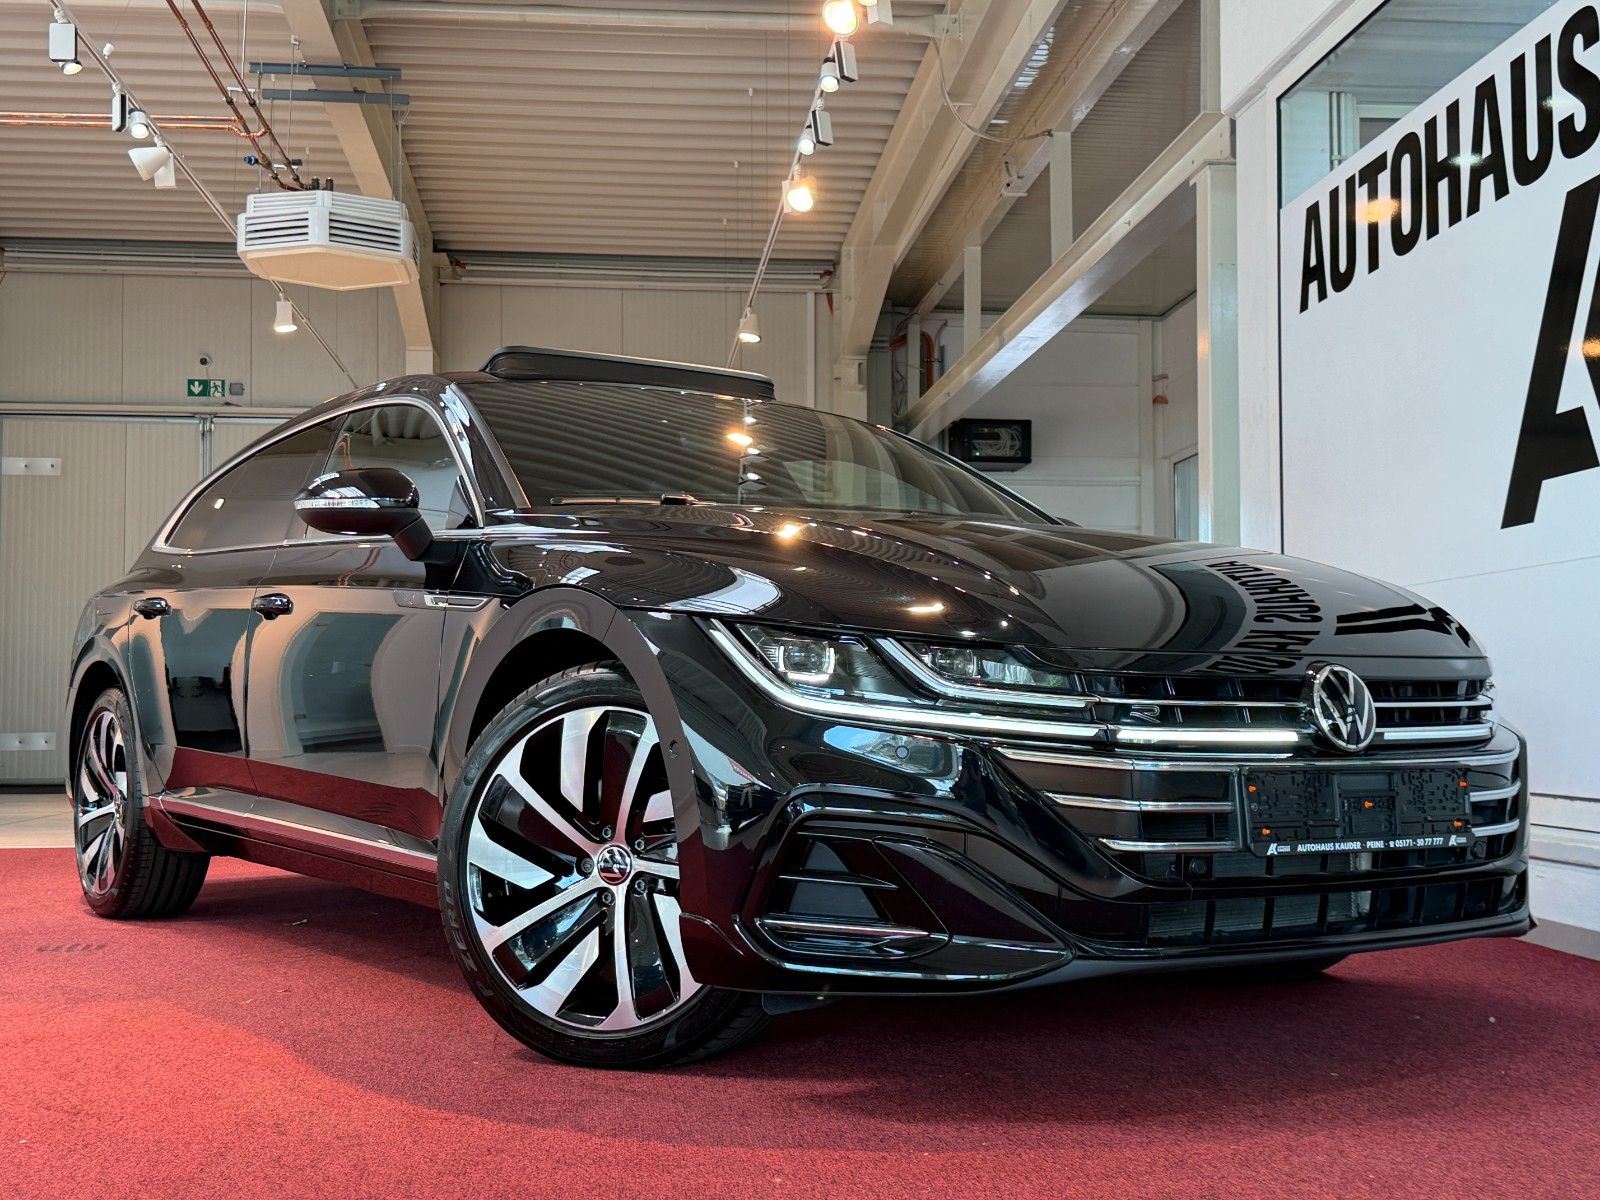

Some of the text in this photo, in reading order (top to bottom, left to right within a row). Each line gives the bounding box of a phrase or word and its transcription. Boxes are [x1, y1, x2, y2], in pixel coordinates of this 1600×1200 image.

[1300, 5, 1600, 315] AUTOHAUS
[1297, 843, 1335, 852] AUTOHAUS
[1335, 841, 1362, 850] KAUDER
[1366, 841, 1385, 849] PEINE
[1395, 839, 1413, 848] 05171
